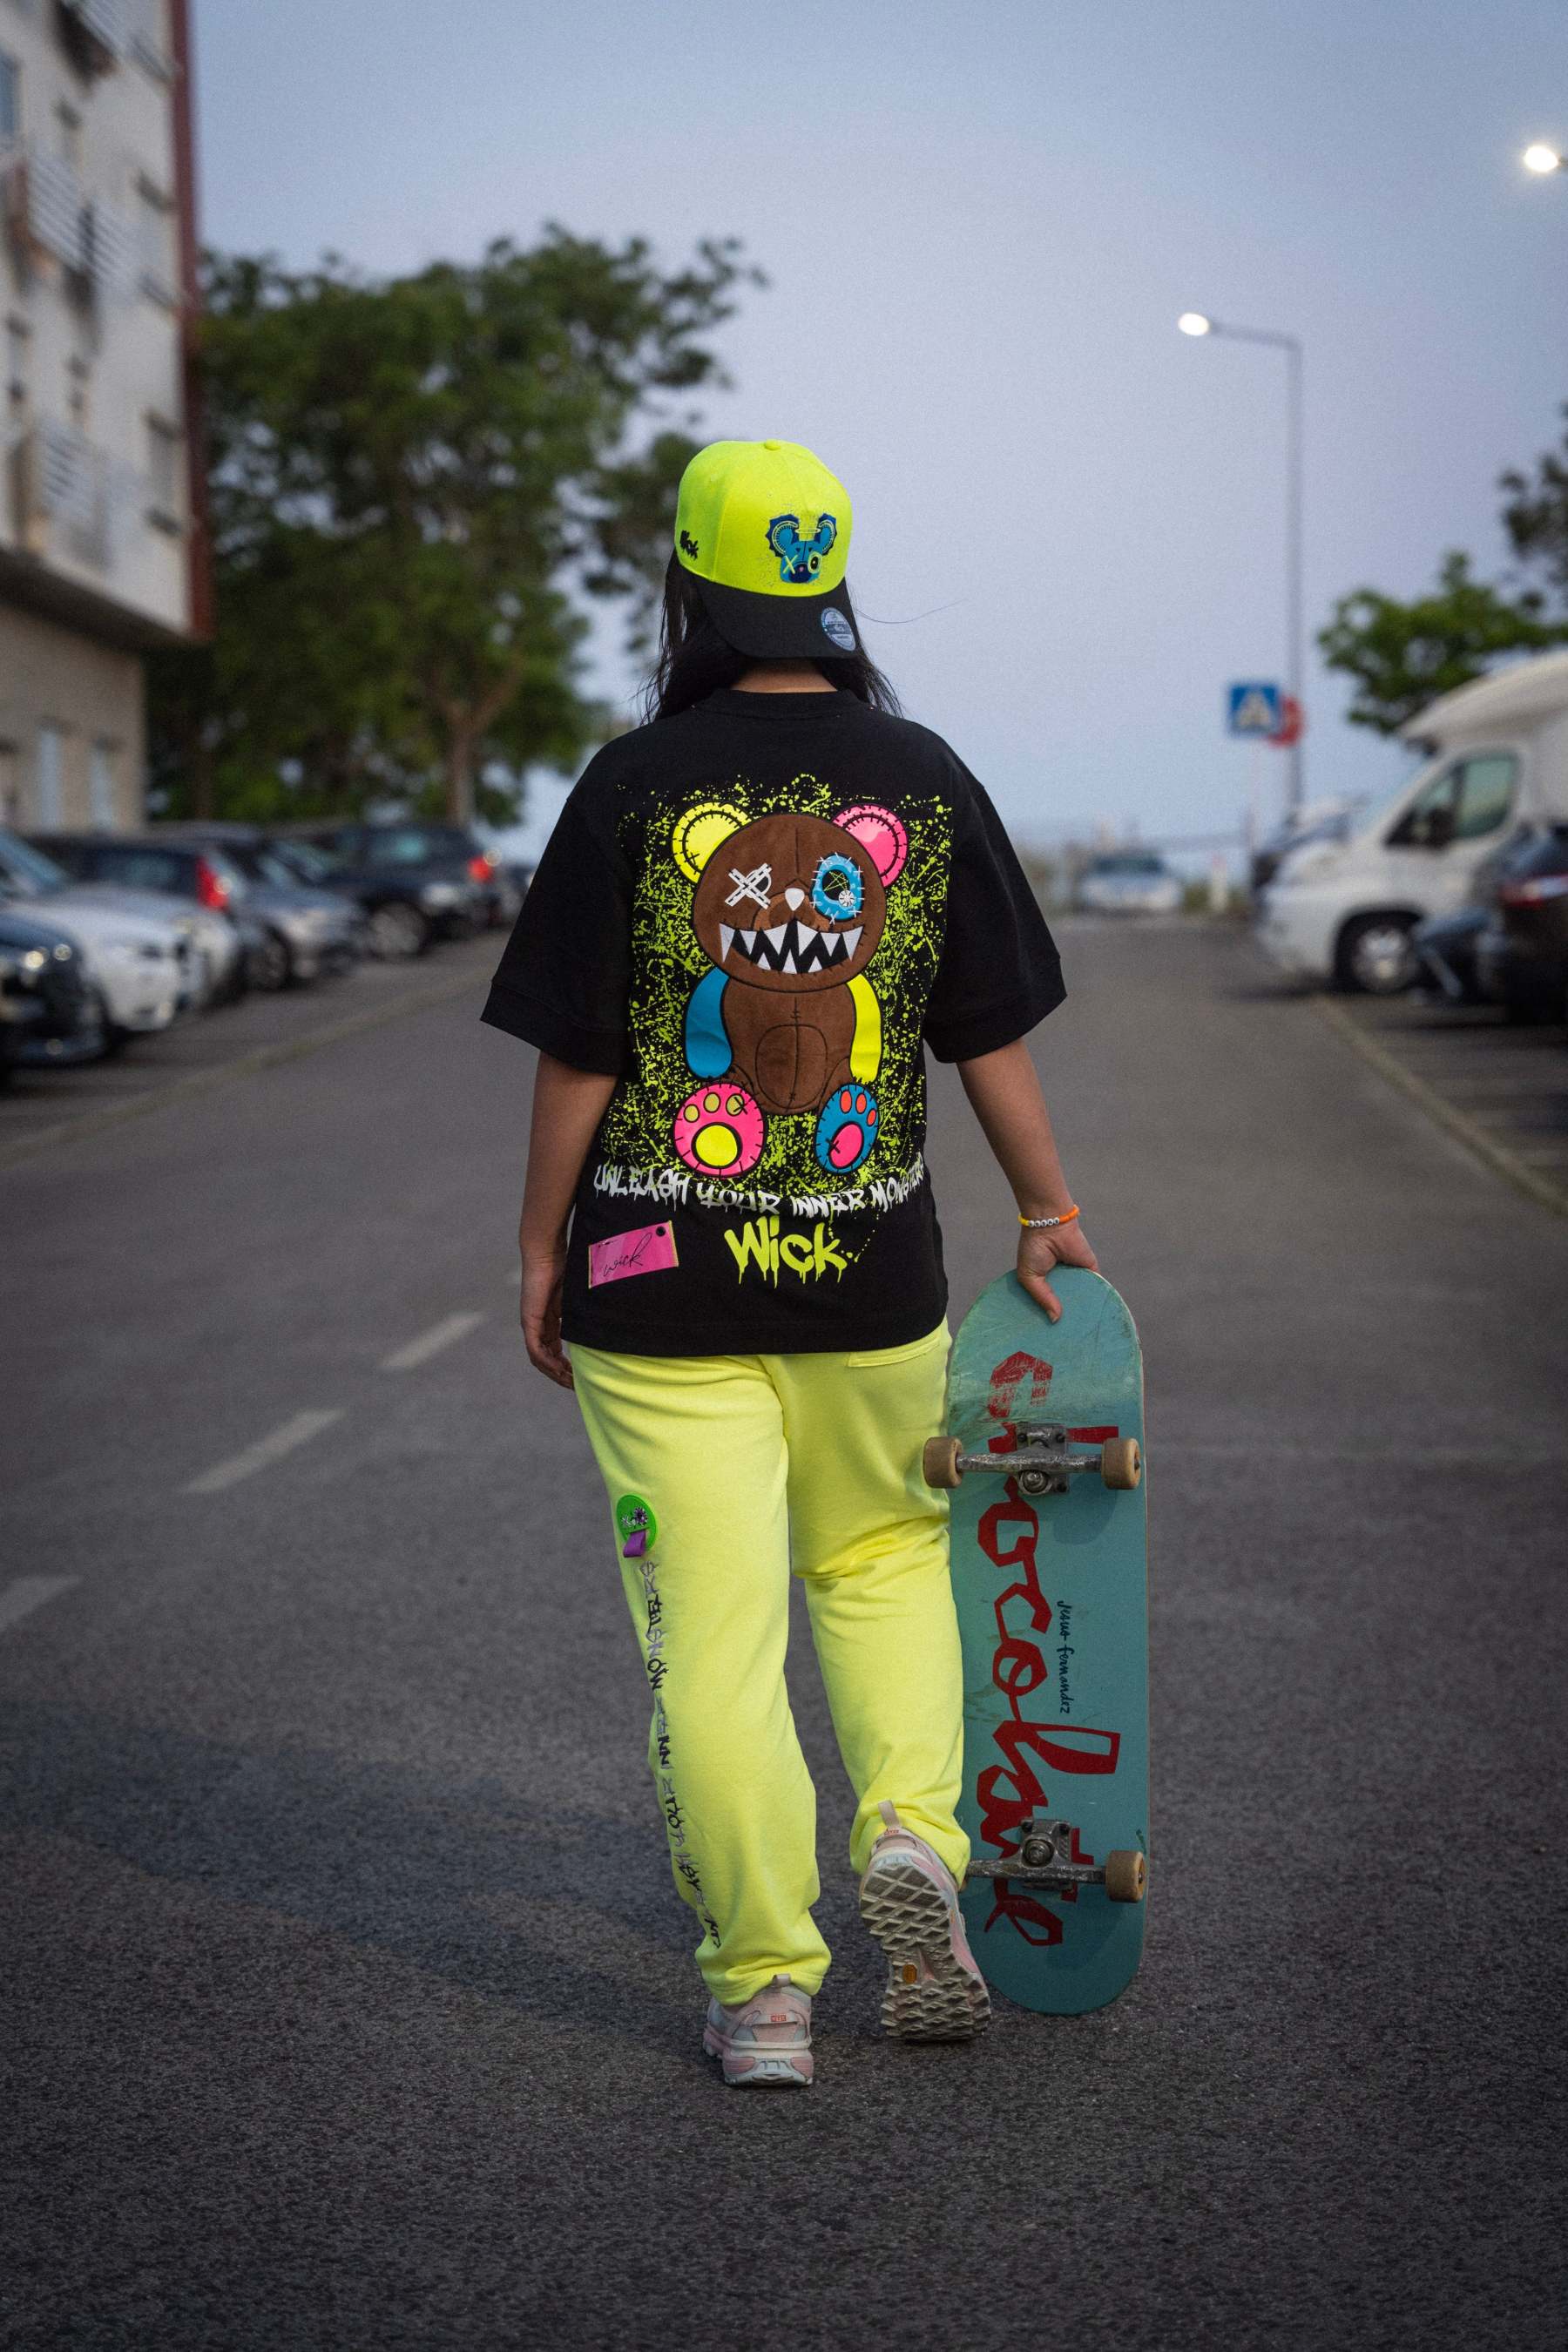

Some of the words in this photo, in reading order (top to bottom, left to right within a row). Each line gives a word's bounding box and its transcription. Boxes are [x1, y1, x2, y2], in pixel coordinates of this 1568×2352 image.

[593, 1165, 690, 1212] UNLEASH
[696, 1181, 780, 1215] YOUR
[790, 1189, 868, 1218] INNER
